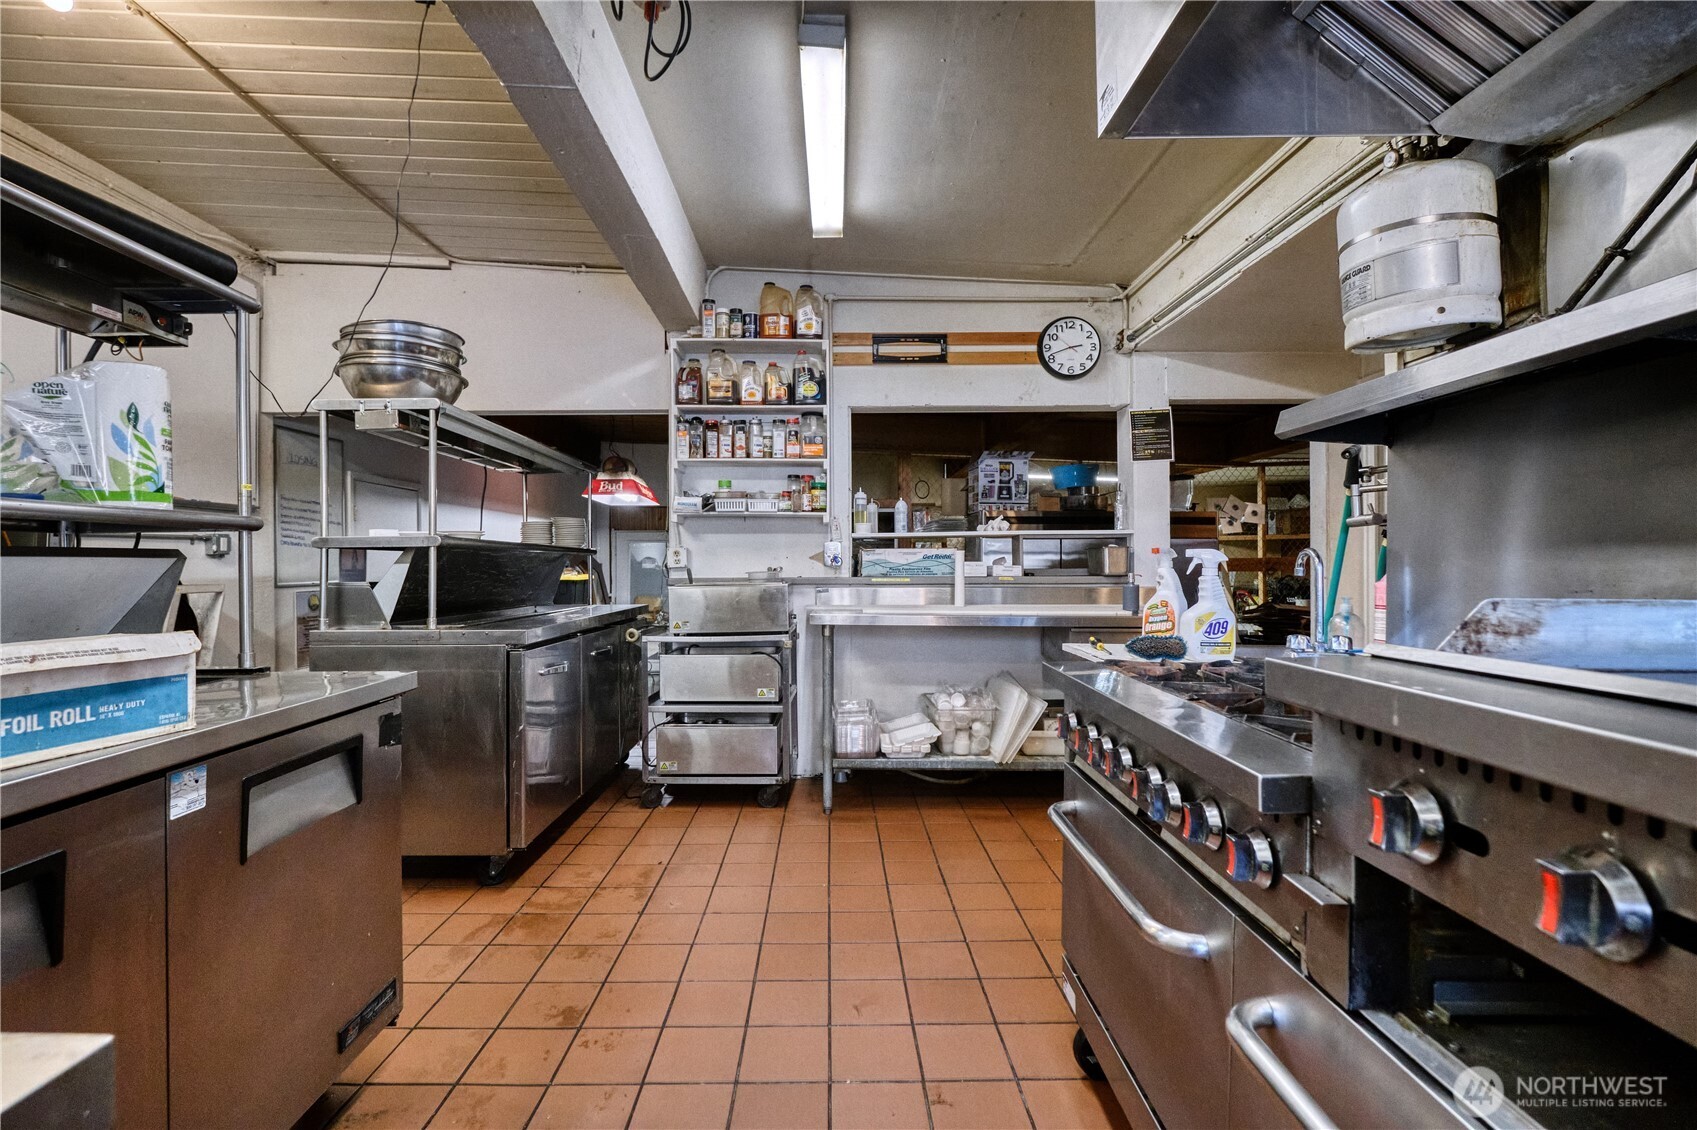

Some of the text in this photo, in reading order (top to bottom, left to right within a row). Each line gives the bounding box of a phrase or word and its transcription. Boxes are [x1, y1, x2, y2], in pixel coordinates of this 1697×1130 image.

[1054, 324, 1064, 333] 11
[1064, 320, 1075, 329] 12
[1079, 323, 1083, 331] 1
[1047, 333, 1058, 341] 10
[1086, 330, 1093, 339] 2
[1043, 343, 1051, 352] 9
[1090, 342, 1097, 351] 3
[1047, 354, 1055, 364] 8
[1085, 354, 1093, 362] 4
[1057, 363, 1064, 371] 7
[1067, 366, 1075, 374] 6
[1079, 363, 1086, 371] 5
[33, 381, 64, 389] open
[31, 387, 68, 395] nature
[598, 481, 623, 493] Bud
[1204, 620, 1229, 636] 409
[99, 699, 146, 713] HEAVY DUTY
[0, 706, 96, 737] FOIL ROLL
